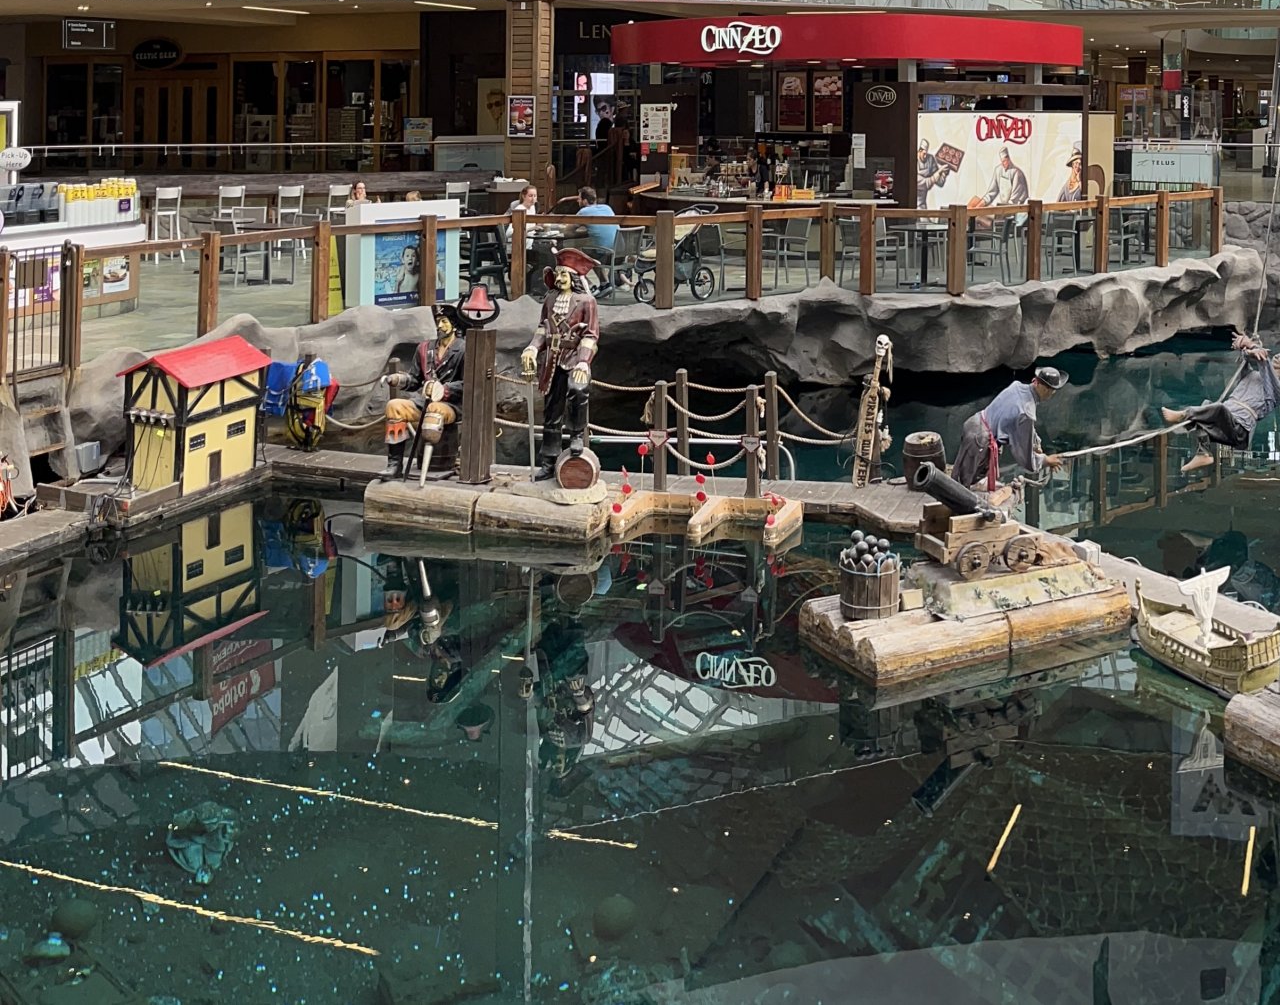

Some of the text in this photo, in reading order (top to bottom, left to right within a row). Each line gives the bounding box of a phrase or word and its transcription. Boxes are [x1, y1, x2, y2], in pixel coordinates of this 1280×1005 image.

[701, 21, 783, 55] CINNZEO
[864, 394, 877, 434] PIRATES
[856, 439, 872, 489] QUATERS
